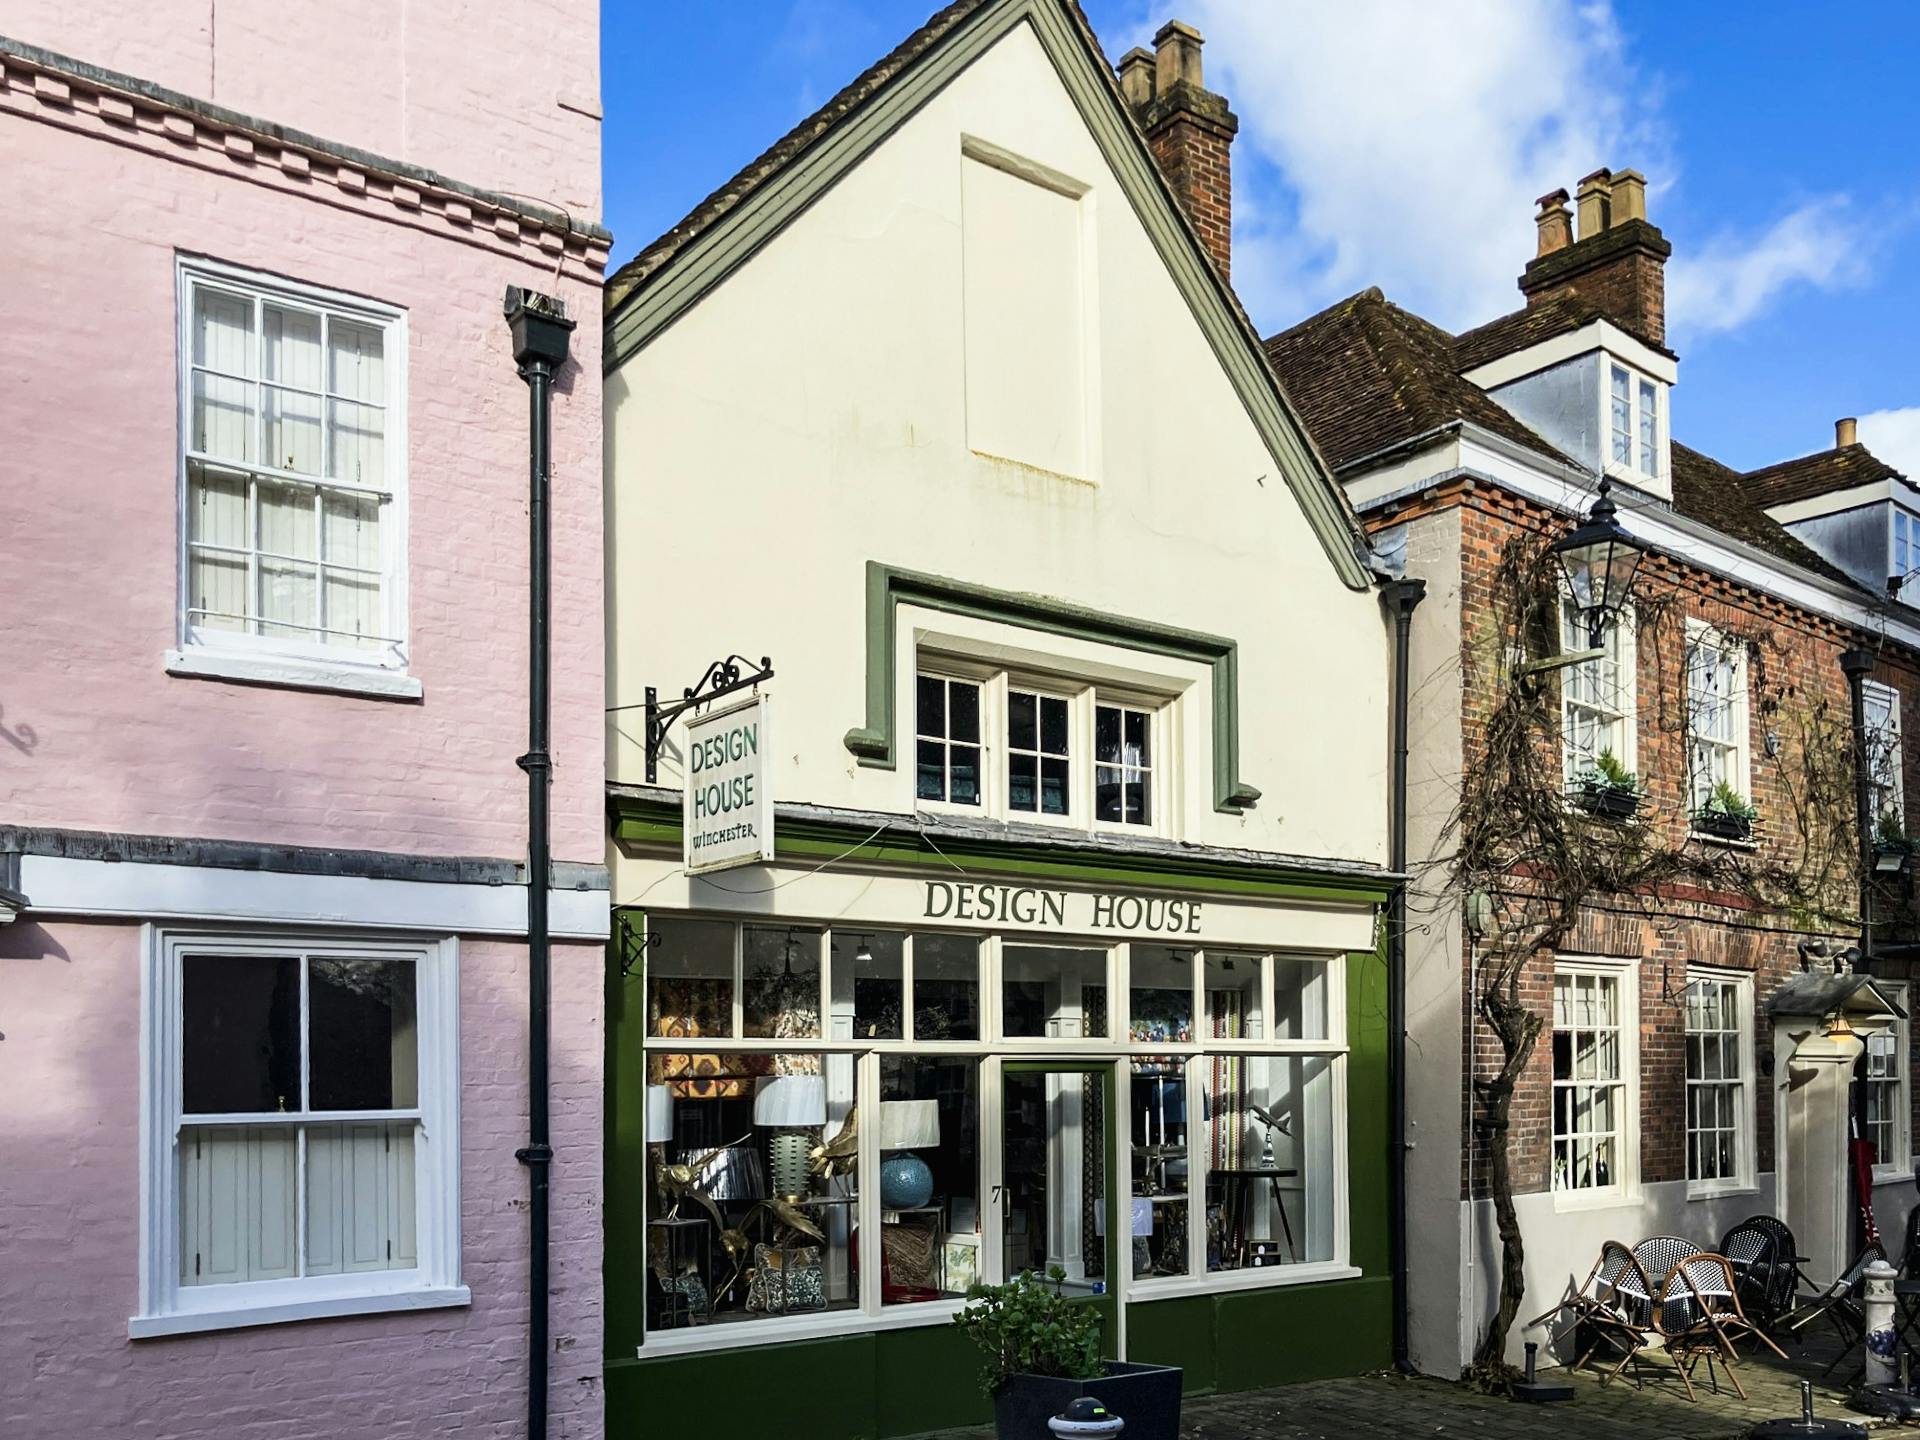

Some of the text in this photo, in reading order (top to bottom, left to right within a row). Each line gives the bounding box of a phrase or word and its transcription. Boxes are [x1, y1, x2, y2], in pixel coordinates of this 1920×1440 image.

[691, 722, 757, 774] DESIGN
[695, 774, 754, 819] HOUSE
[923, 881, 1202, 934] DESIGN HOUSE
[992, 1185, 1002, 1203] 7
